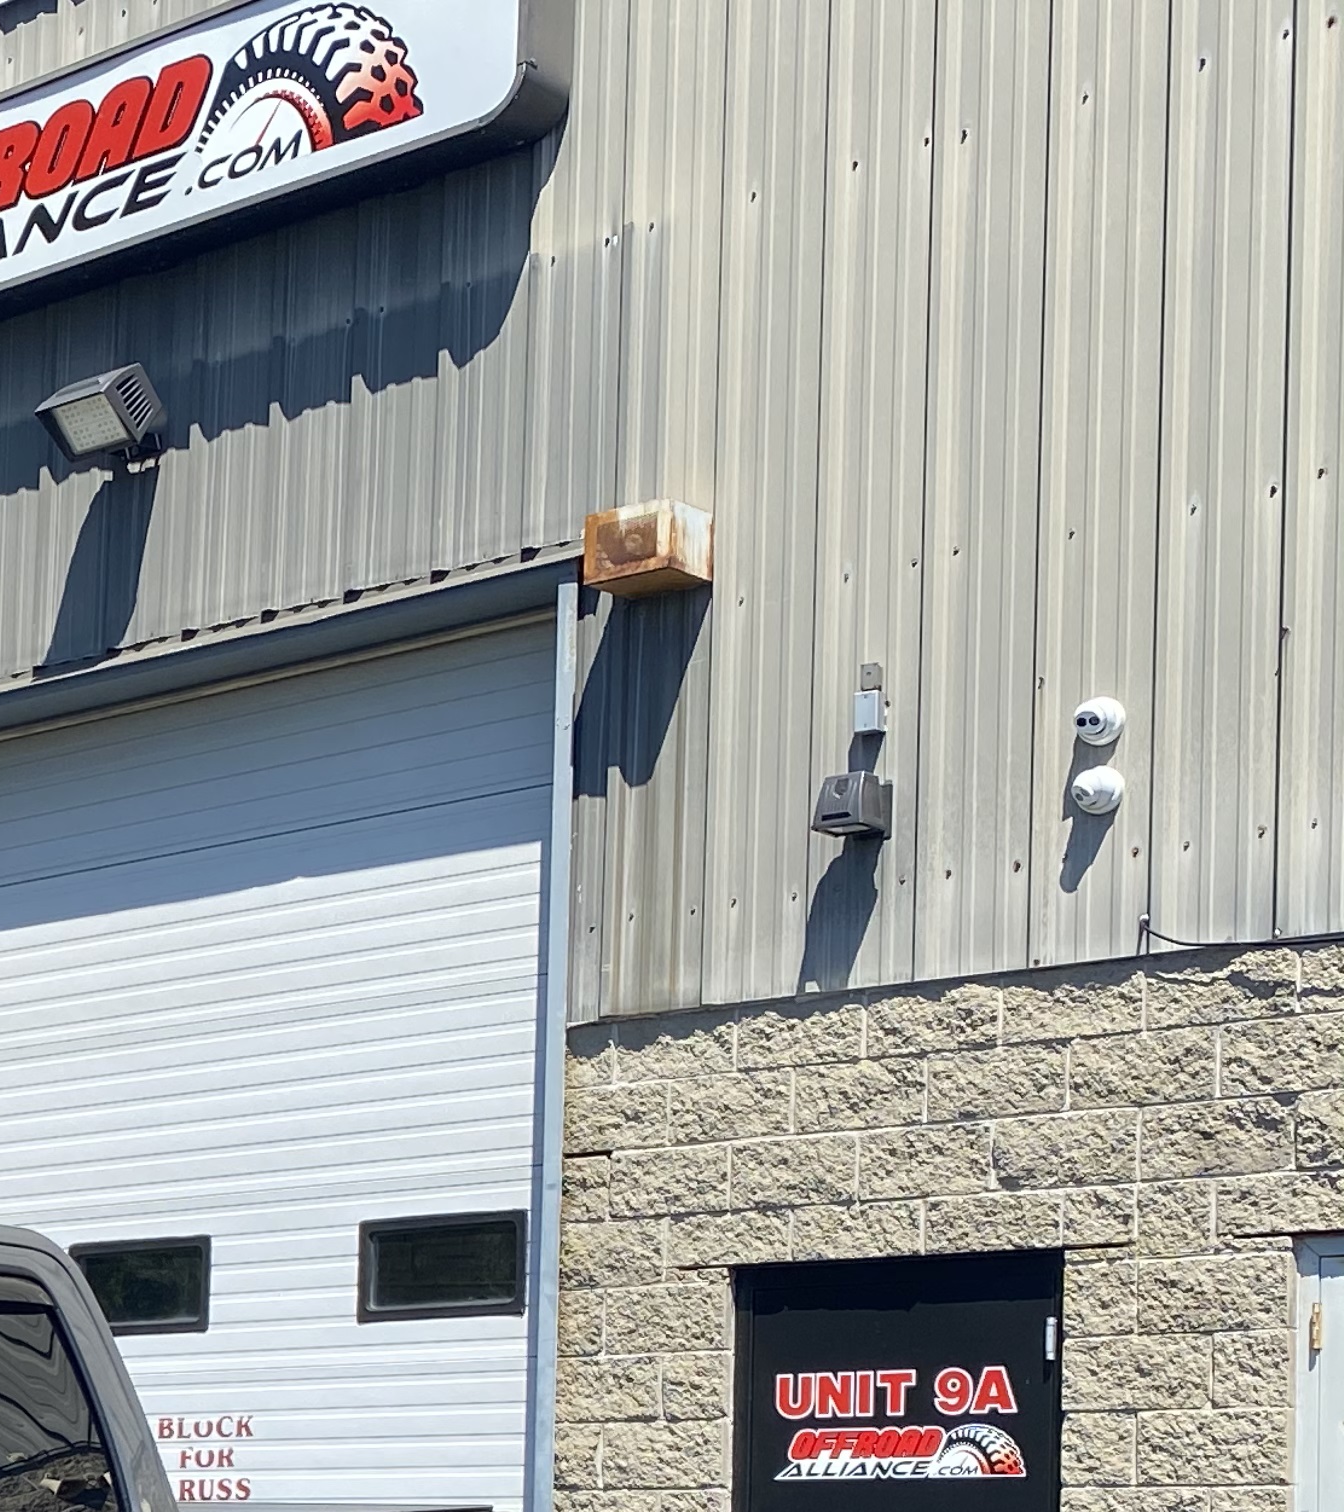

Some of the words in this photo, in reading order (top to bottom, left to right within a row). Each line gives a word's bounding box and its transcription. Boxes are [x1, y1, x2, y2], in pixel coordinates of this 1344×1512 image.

[775, 1368, 917, 1420] UNIT
[934, 1366, 1018, 1415] 9A
[158, 1415, 254, 1439] BLOCK
[789, 1427, 946, 1460] OFFROAD
[179, 1447, 235, 1469] FOR
[179, 1478, 252, 1501] RUSS
